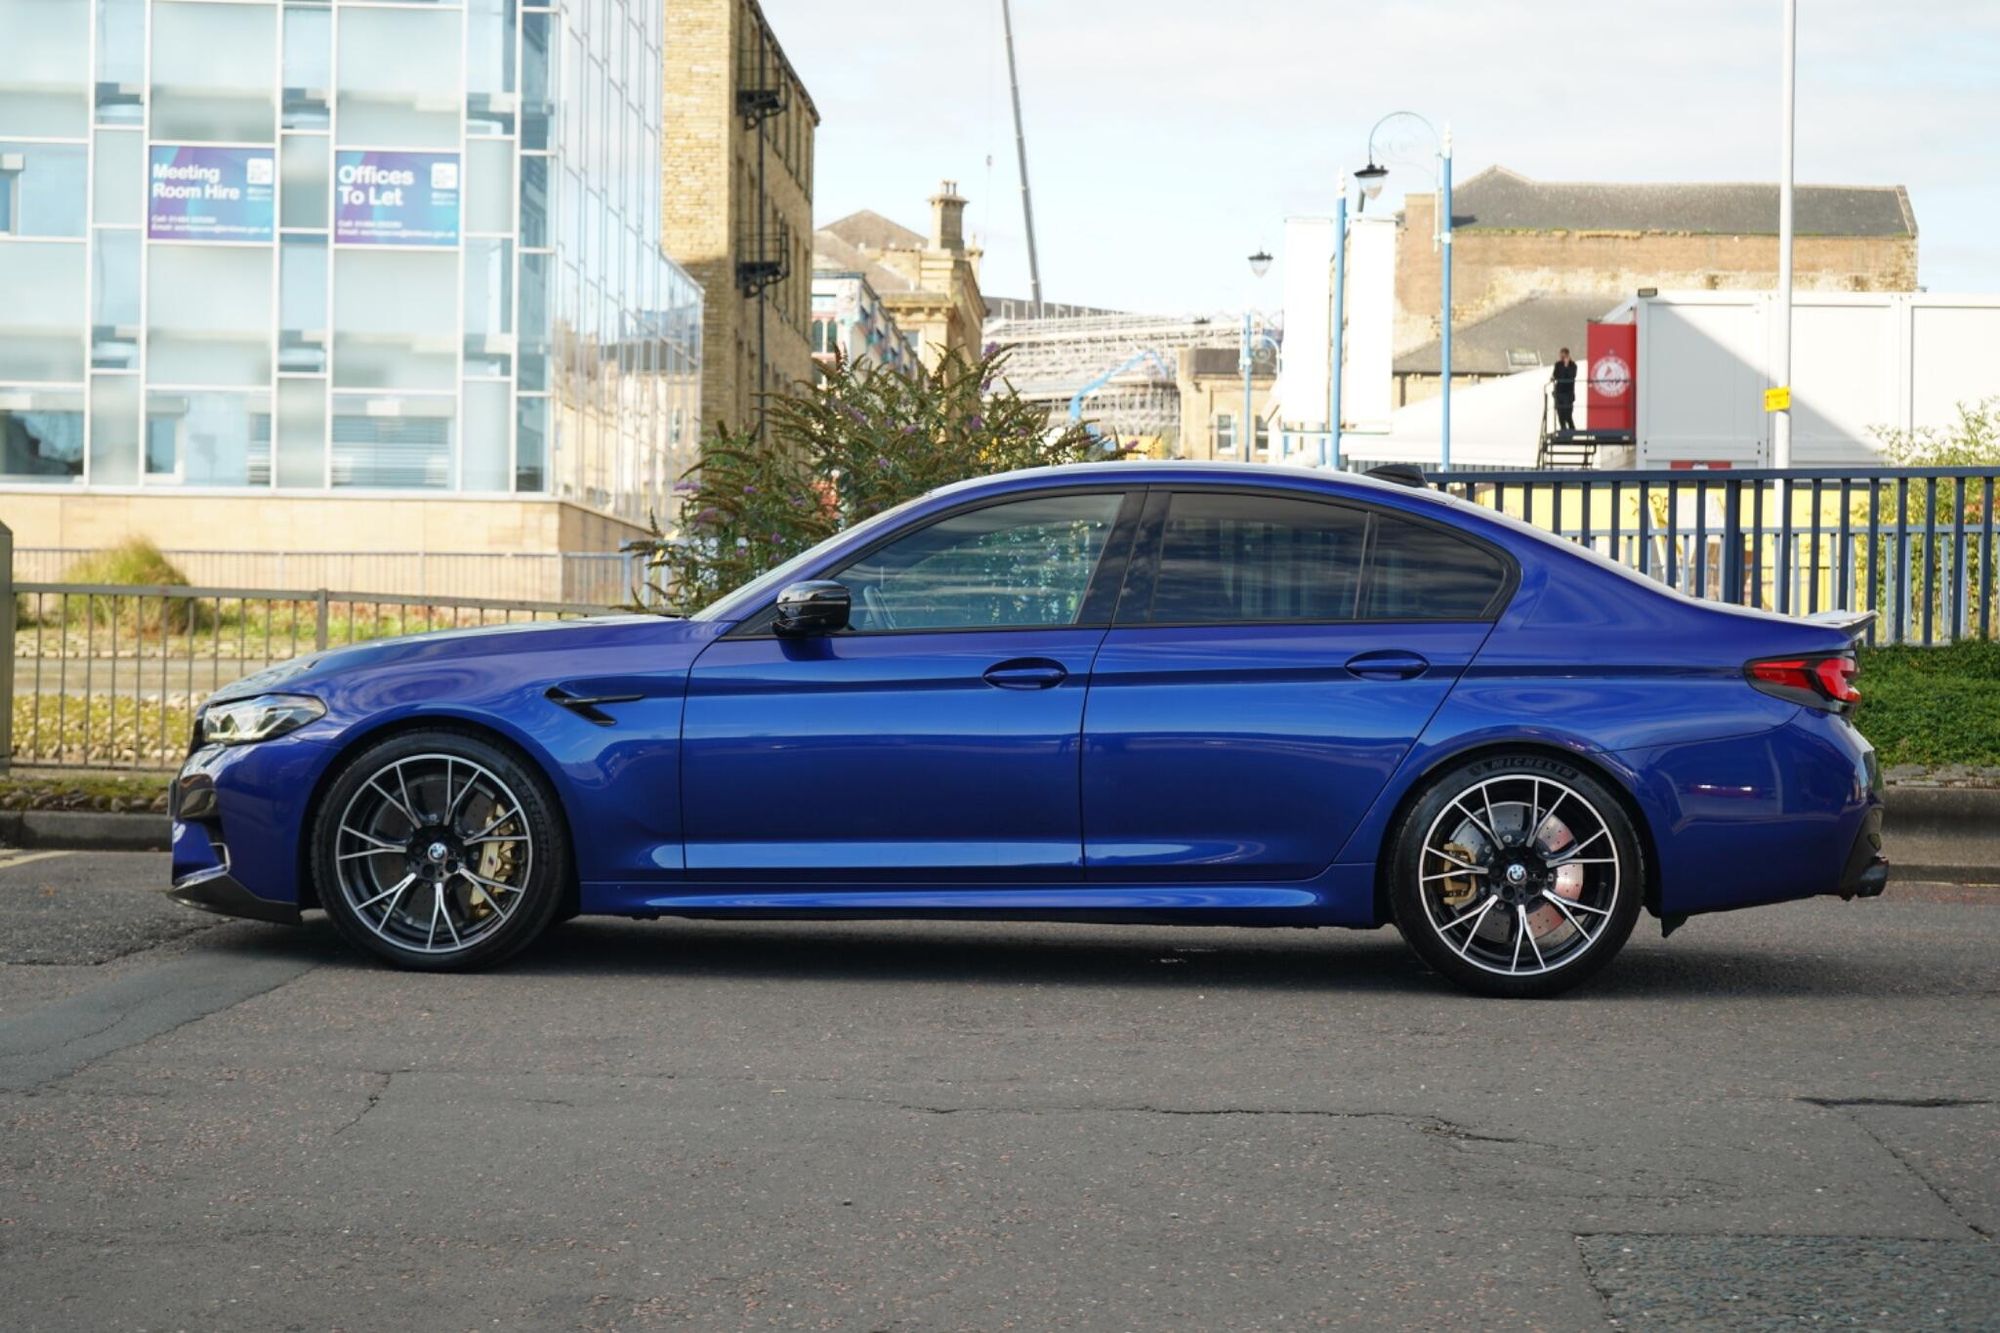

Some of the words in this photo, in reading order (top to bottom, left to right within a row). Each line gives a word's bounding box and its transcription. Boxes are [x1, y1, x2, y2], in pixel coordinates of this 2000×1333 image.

[152, 163, 220, 184] Meeting
[338, 165, 414, 186] Offices
[152, 182, 201, 199] Room
[204, 184, 240, 201] Hire
[338, 185, 365, 206] To
[368, 186, 404, 207] Let
